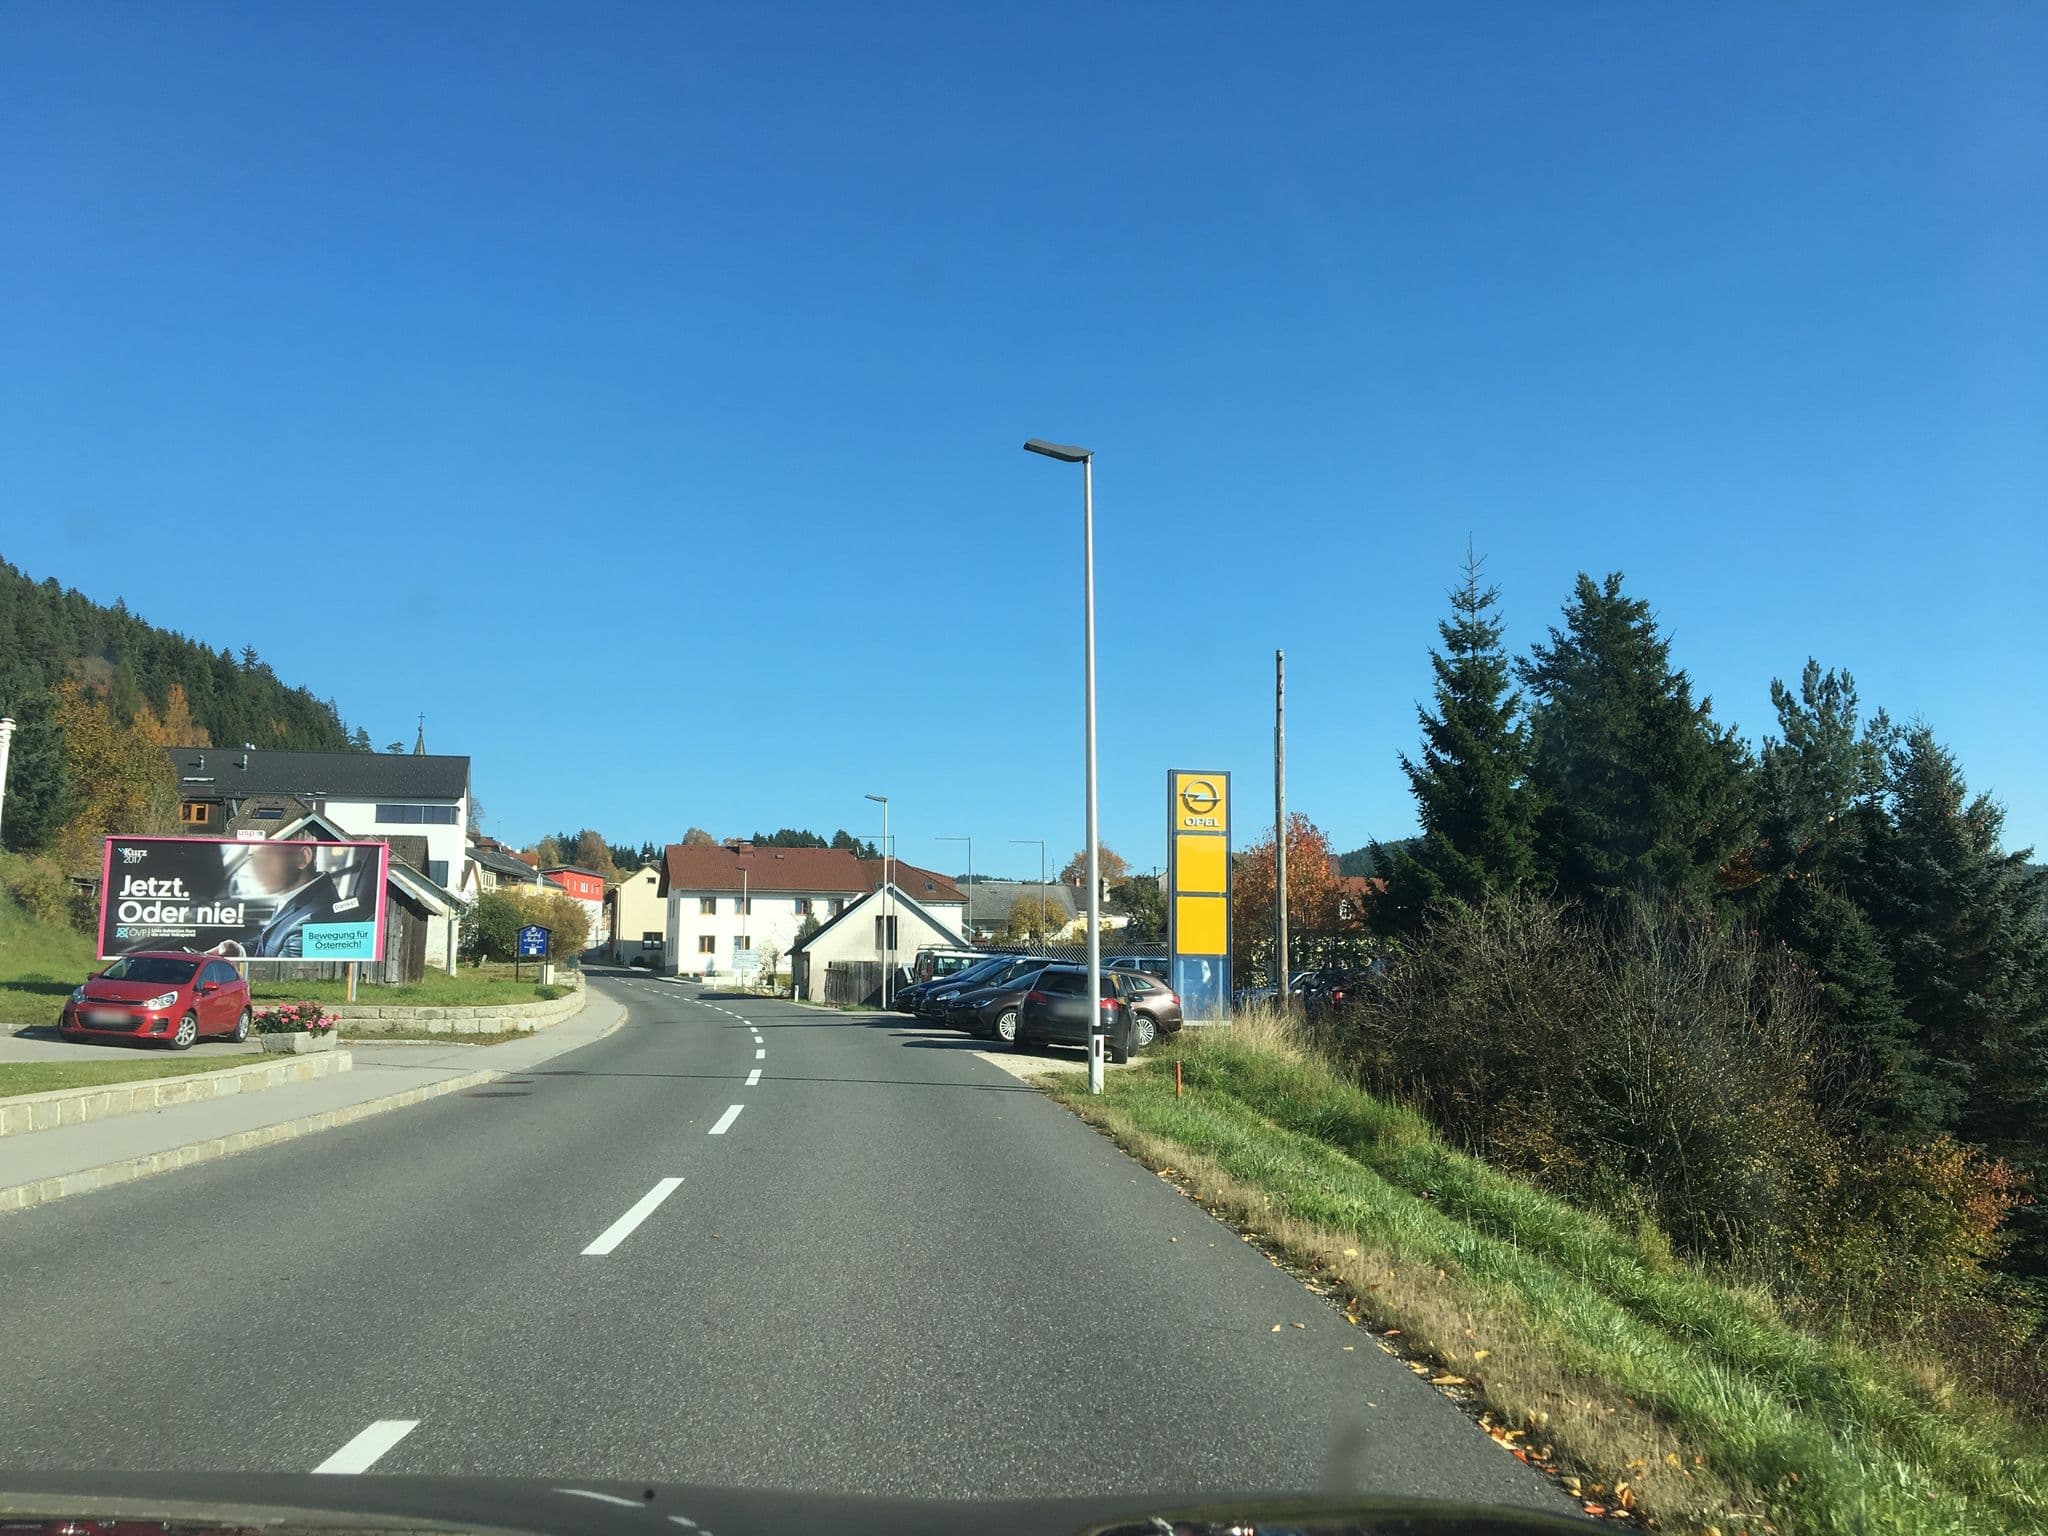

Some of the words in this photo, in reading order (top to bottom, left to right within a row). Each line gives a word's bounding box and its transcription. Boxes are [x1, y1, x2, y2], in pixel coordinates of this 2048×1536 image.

[1184, 817, 1221, 828] OPEL
[124, 847, 148, 857] Kurz
[123, 855, 143, 864] 2017
[119, 874, 190, 897] Jetzt.
[118, 900, 190, 923] Oder
[196, 901, 245, 924] nie!
[308, 931, 355, 941] Bewegung
[356, 930, 369, 940] für
[314, 939, 362, 949] Österreich!
